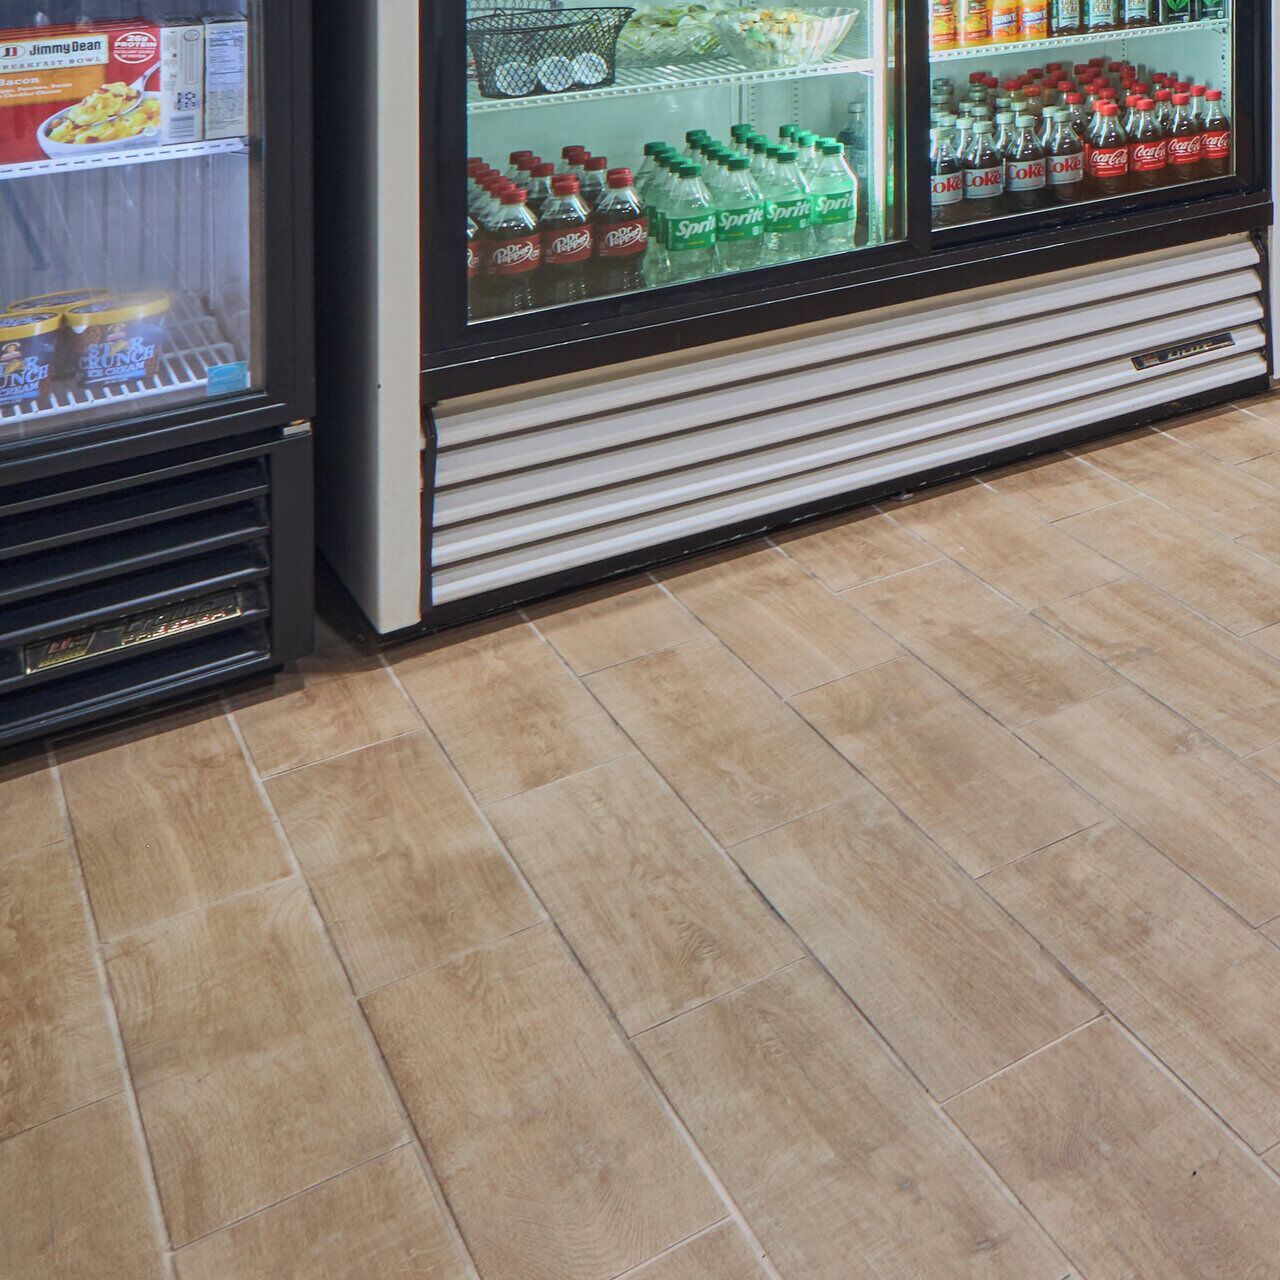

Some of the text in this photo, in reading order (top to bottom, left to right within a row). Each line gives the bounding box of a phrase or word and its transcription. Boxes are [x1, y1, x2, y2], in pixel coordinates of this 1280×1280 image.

[29, 40, 101, 56] Jimmy Dean
[69, 57, 101, 65] BOWL
[963, 171, 1001, 188] Coke
[1006, 163, 1044, 180] Coke
[719, 206, 764, 231] Sprite
[767, 200, 811, 223] Sprite
[567, 233, 580, 242] Dr
[607, 228, 642, 247] Pepper
[619, 226, 631, 236] Dr
[508, 243, 522, 253] Dr
[555, 235, 588, 254] Pepper
[497, 246, 530, 265] Pepper
[79, 346, 154, 371] CRUNCH
